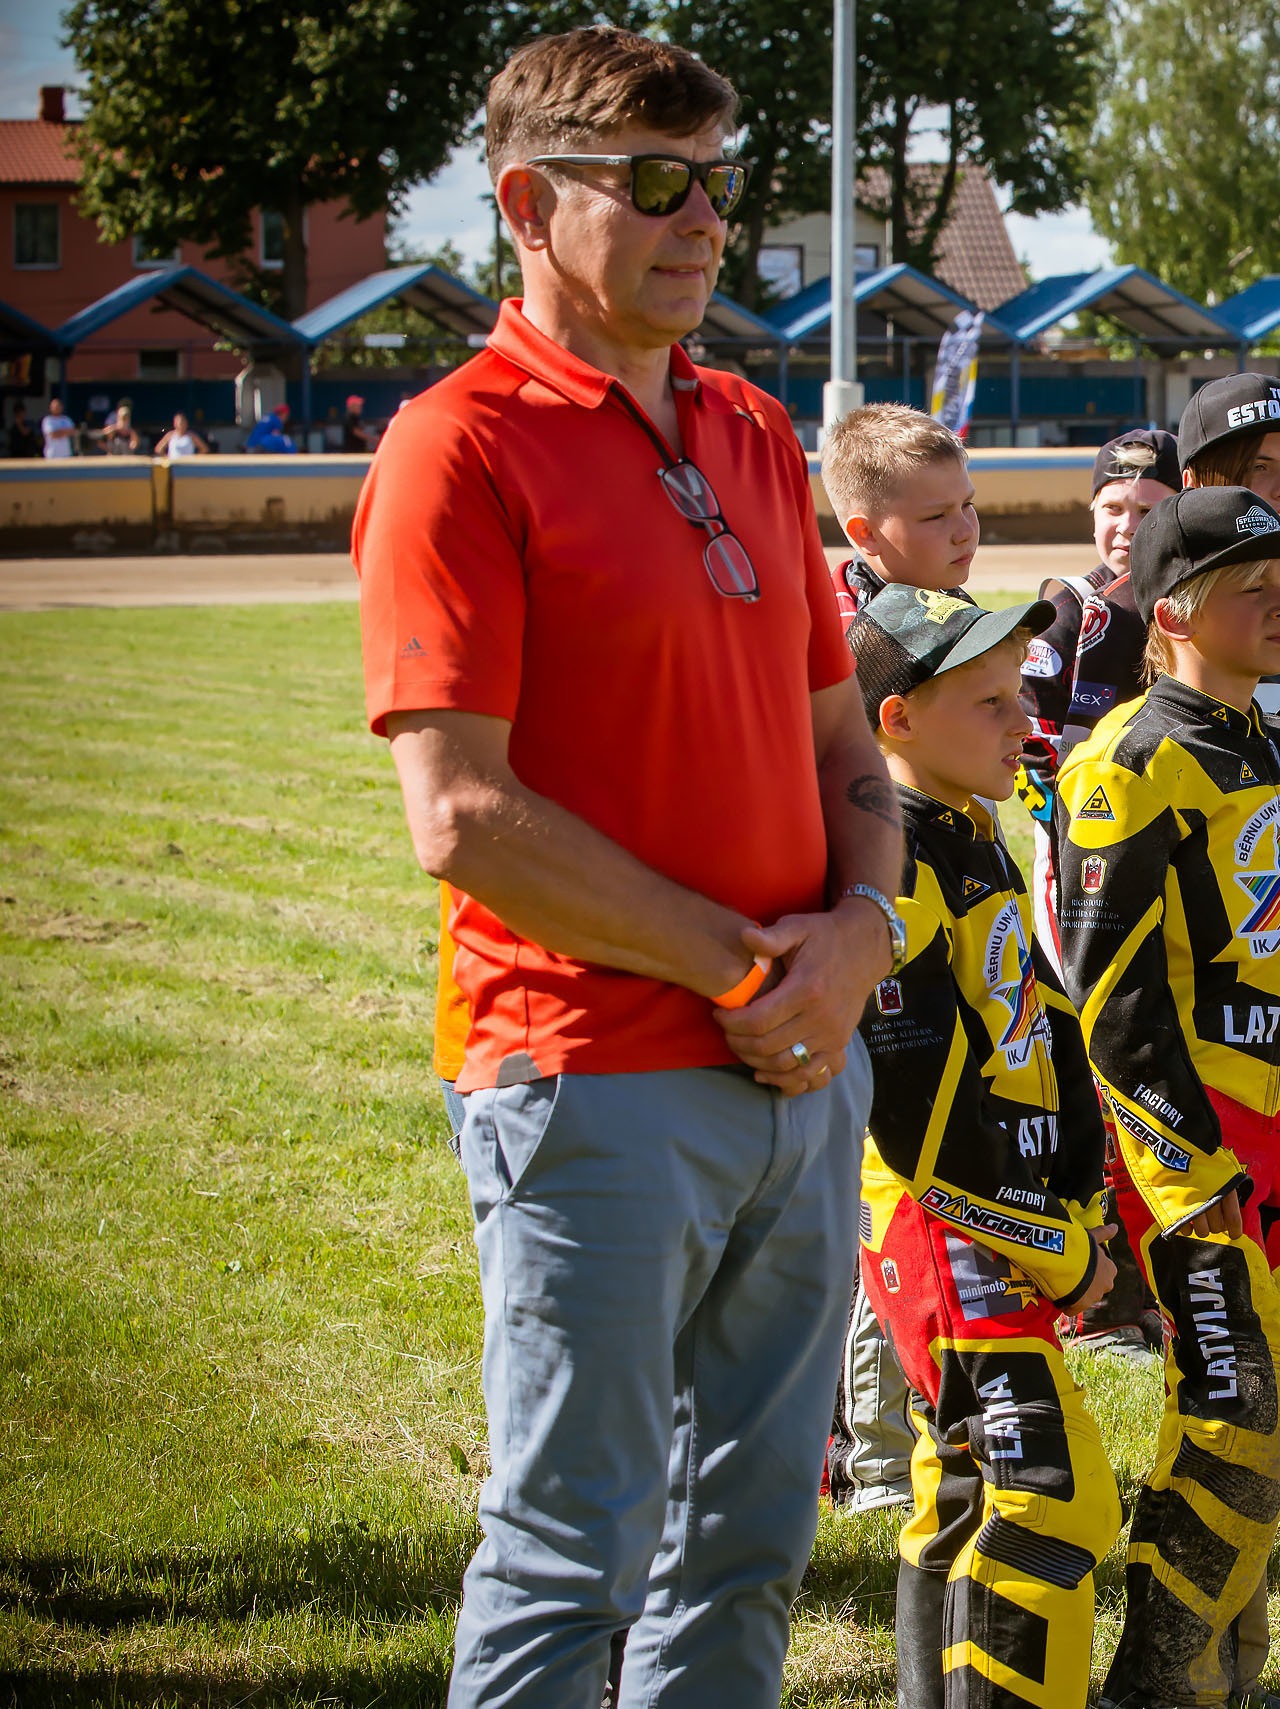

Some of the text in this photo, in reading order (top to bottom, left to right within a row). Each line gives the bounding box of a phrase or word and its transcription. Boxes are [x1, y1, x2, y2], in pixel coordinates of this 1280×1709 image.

[1260, 804, 1278, 821] UN
[1133, 1083, 1184, 1128] FACTORY
[996, 1186, 1047, 1212] FACTORY
[959, 1280, 1006, 1299] minimoto
[1189, 1267, 1240, 1400] LATVIJA
